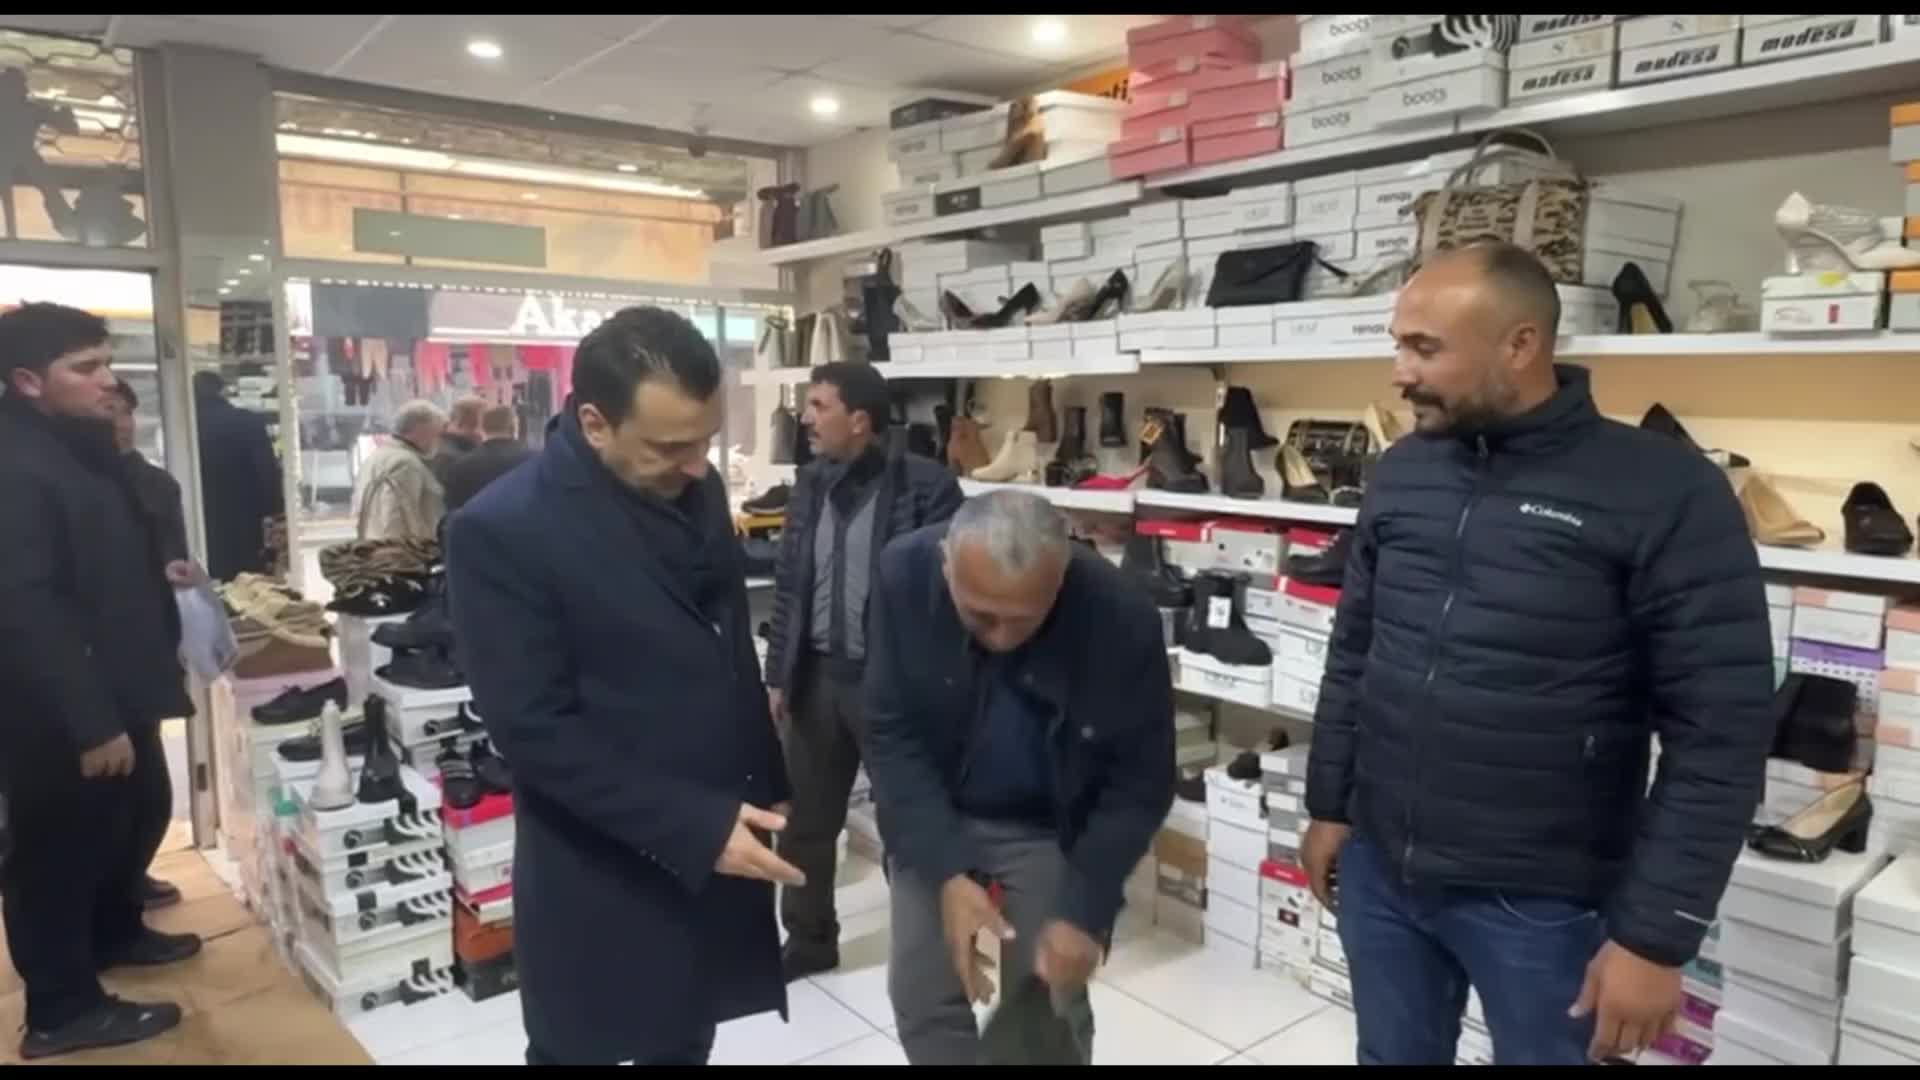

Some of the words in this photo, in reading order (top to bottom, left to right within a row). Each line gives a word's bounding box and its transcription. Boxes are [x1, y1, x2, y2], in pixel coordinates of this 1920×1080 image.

[1760, 19, 1857, 53] modesa
[1634, 44, 1719, 73] modesa
[1321, 66, 1362, 85] boots
[1402, 87, 1447, 107] boots
[1311, 110, 1351, 130] boots
[510, 294, 612, 337] Aka
